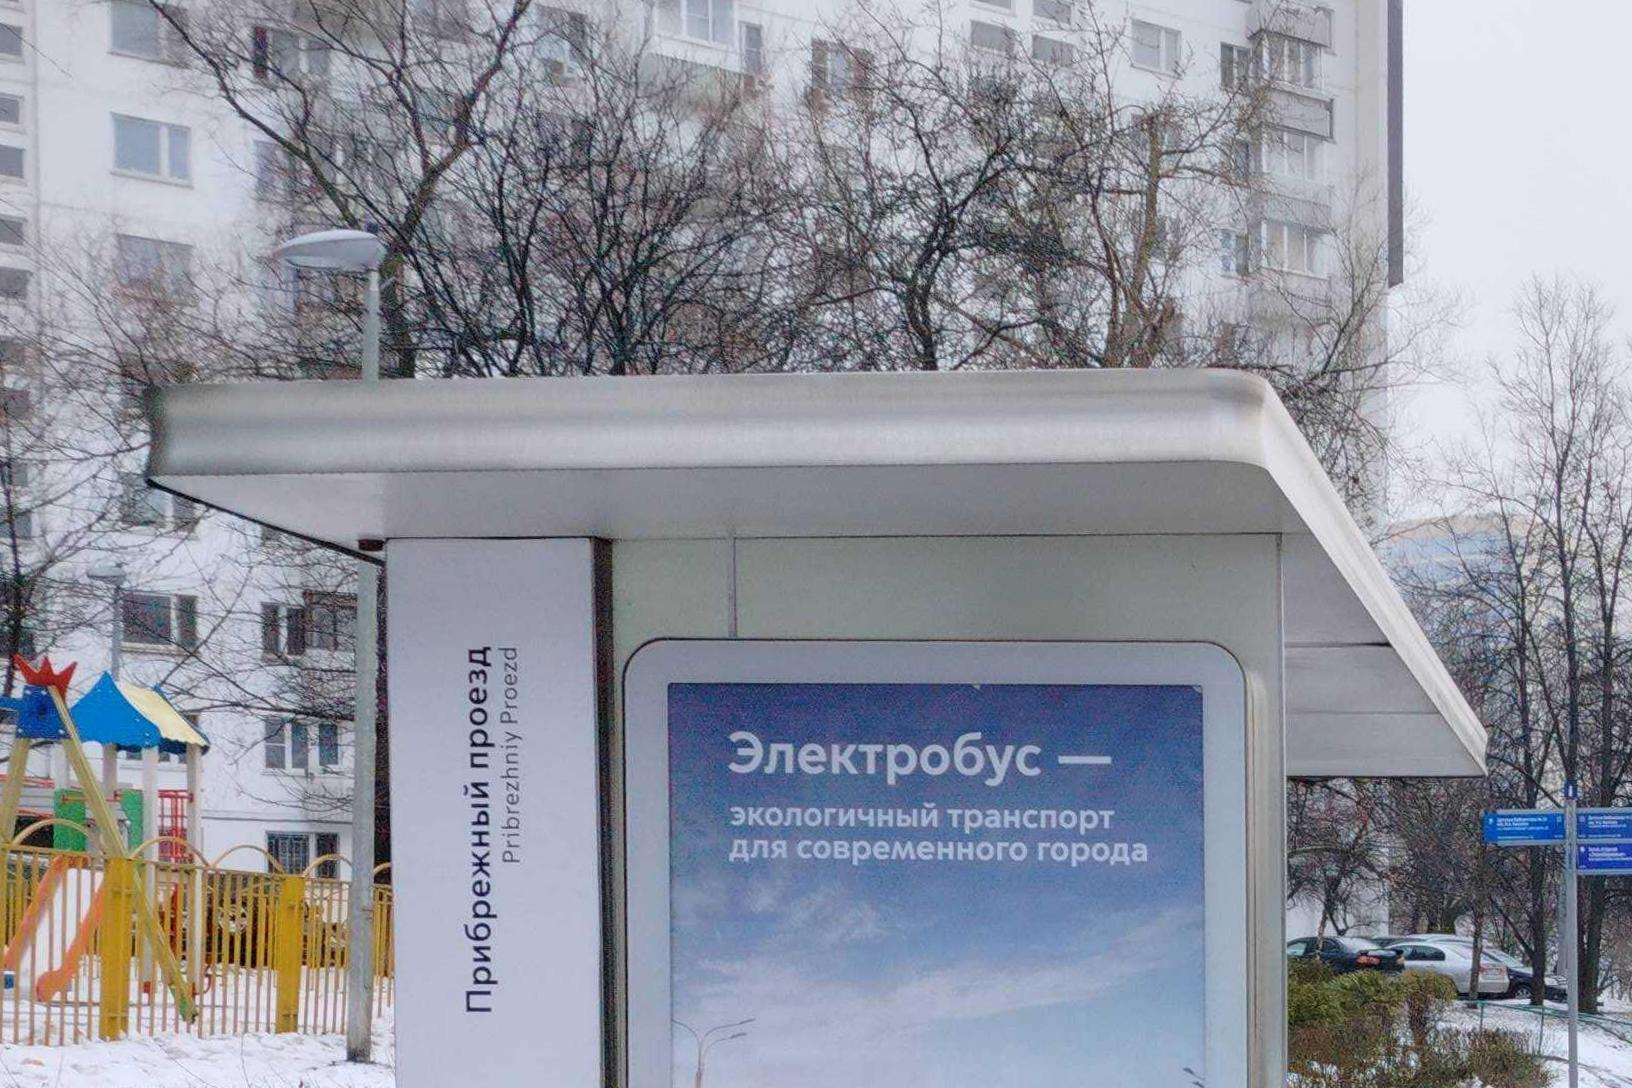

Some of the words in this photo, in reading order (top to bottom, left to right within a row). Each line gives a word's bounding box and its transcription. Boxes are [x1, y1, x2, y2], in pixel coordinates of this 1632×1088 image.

[466, 645, 496, 770] проезд
[500, 646, 522, 725] Proezd
[500, 730, 523, 864] Pribrezhniy
[728, 731, 1042, 787] Электробус
[729, 838, 790, 863] для
[797, 839, 1028, 865] современного
[1037, 842, 1149, 867] города
[730, 803, 939, 834] экологичный
[948, 805, 1115, 834] транспорт
[464, 780, 498, 1013] Прибрежный
